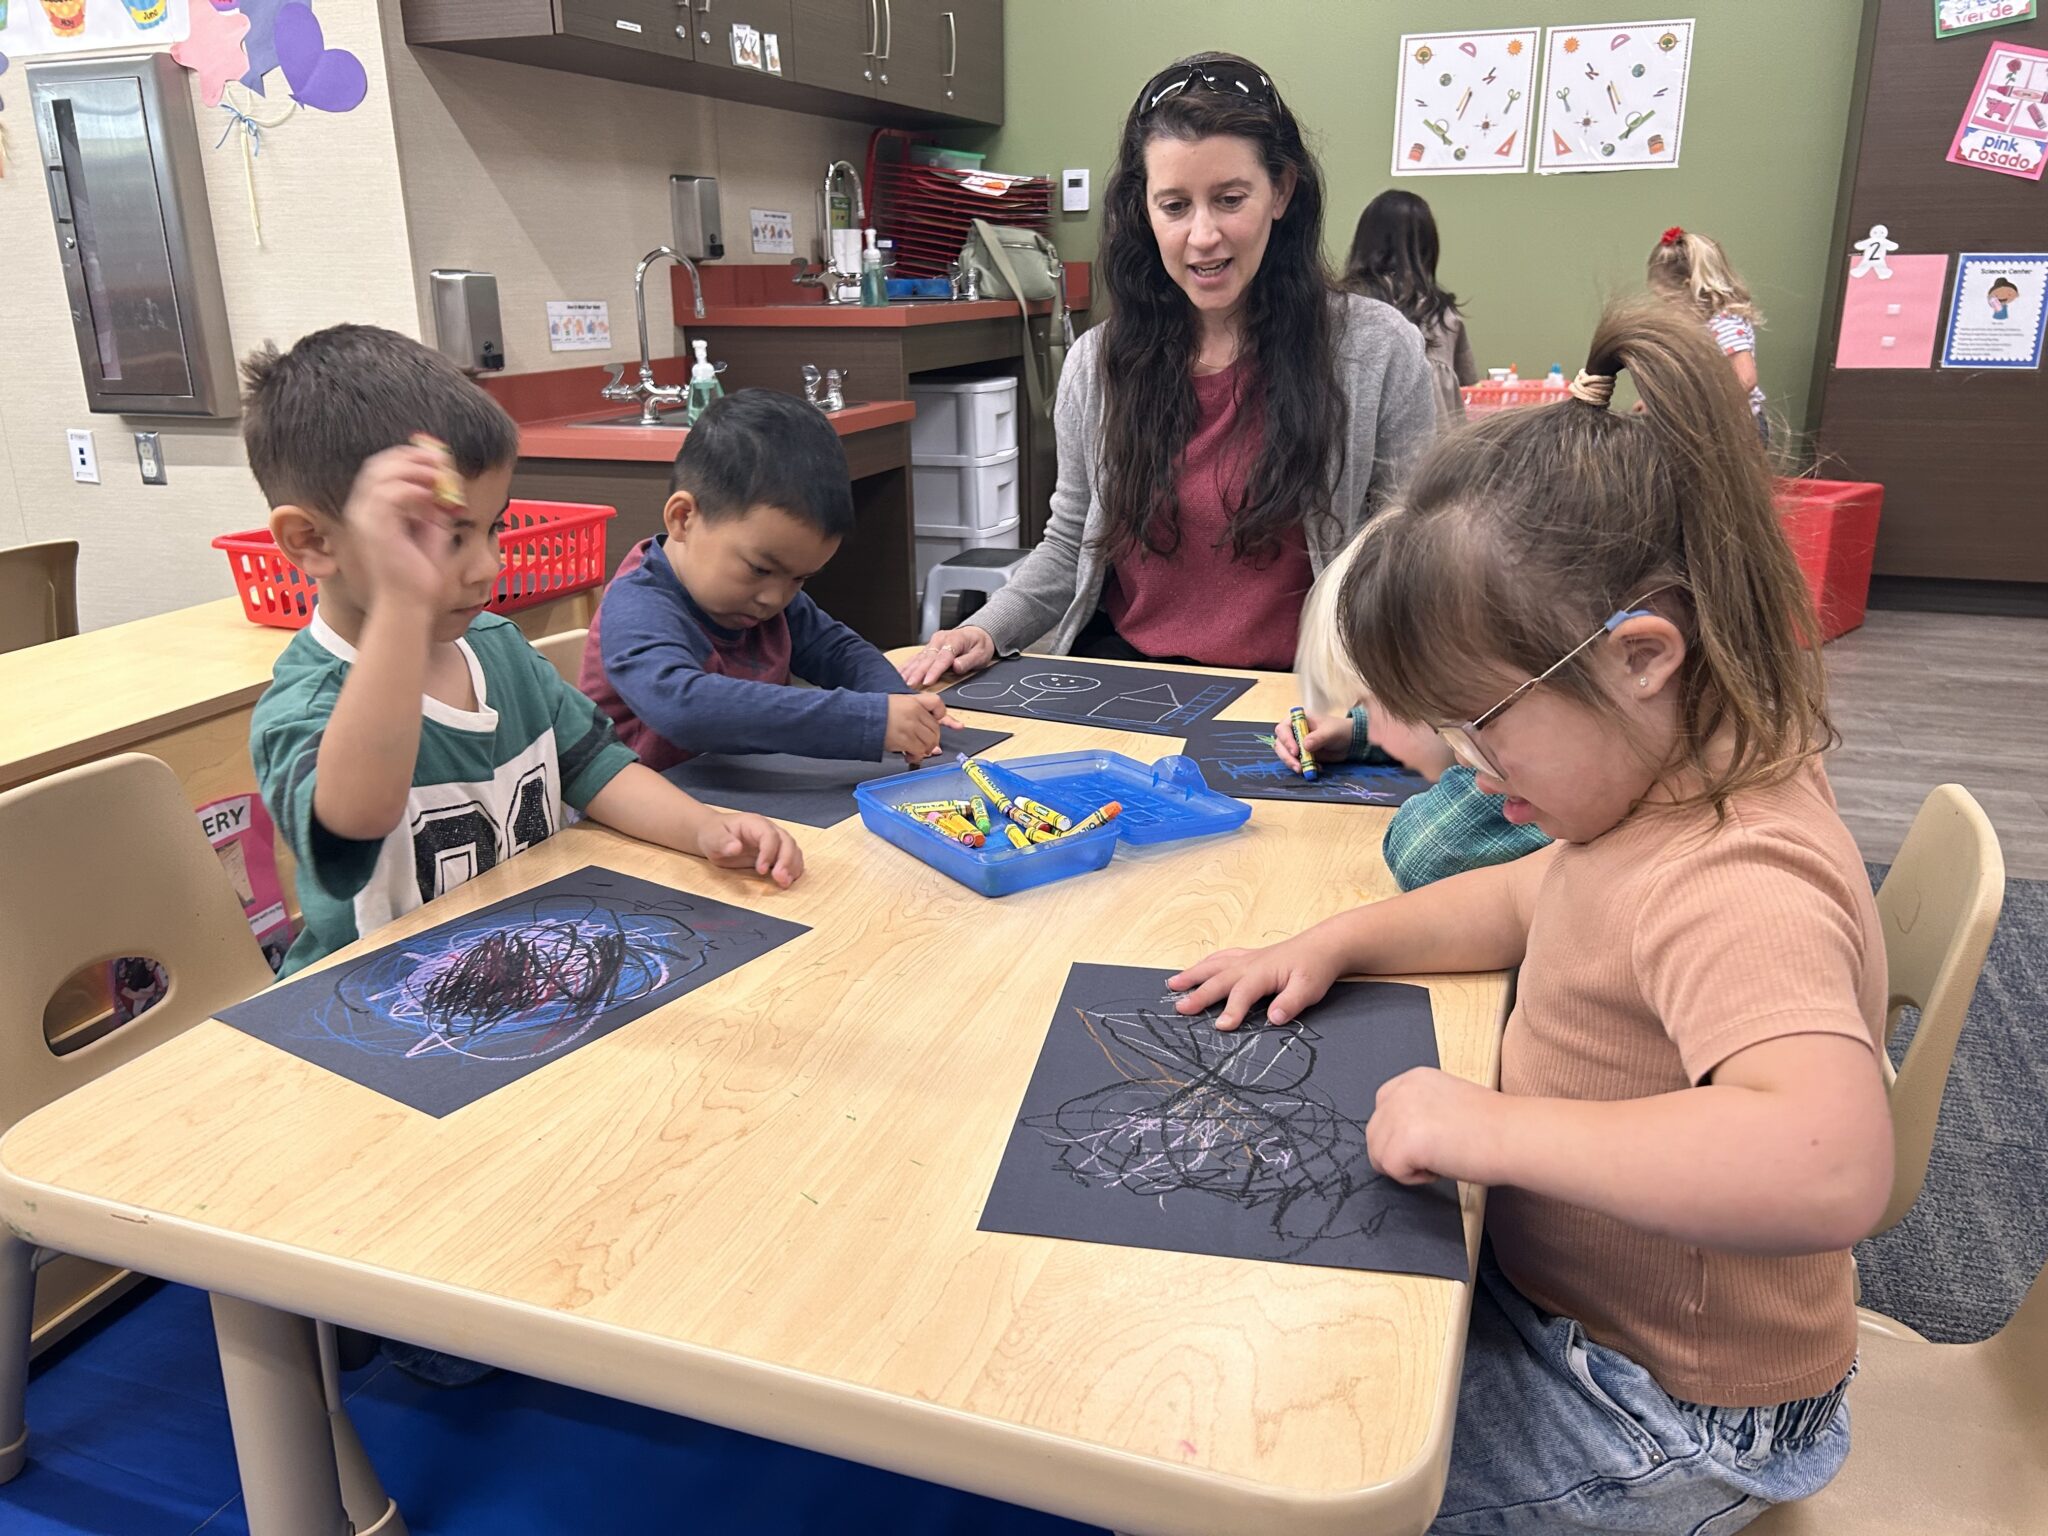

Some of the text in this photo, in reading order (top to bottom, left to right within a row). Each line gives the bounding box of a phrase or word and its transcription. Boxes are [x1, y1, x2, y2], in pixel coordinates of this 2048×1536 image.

[1982, 135, 2019, 152] pink
[1968, 148, 2030, 170] rosado
[1869, 242, 1881, 261] 2
